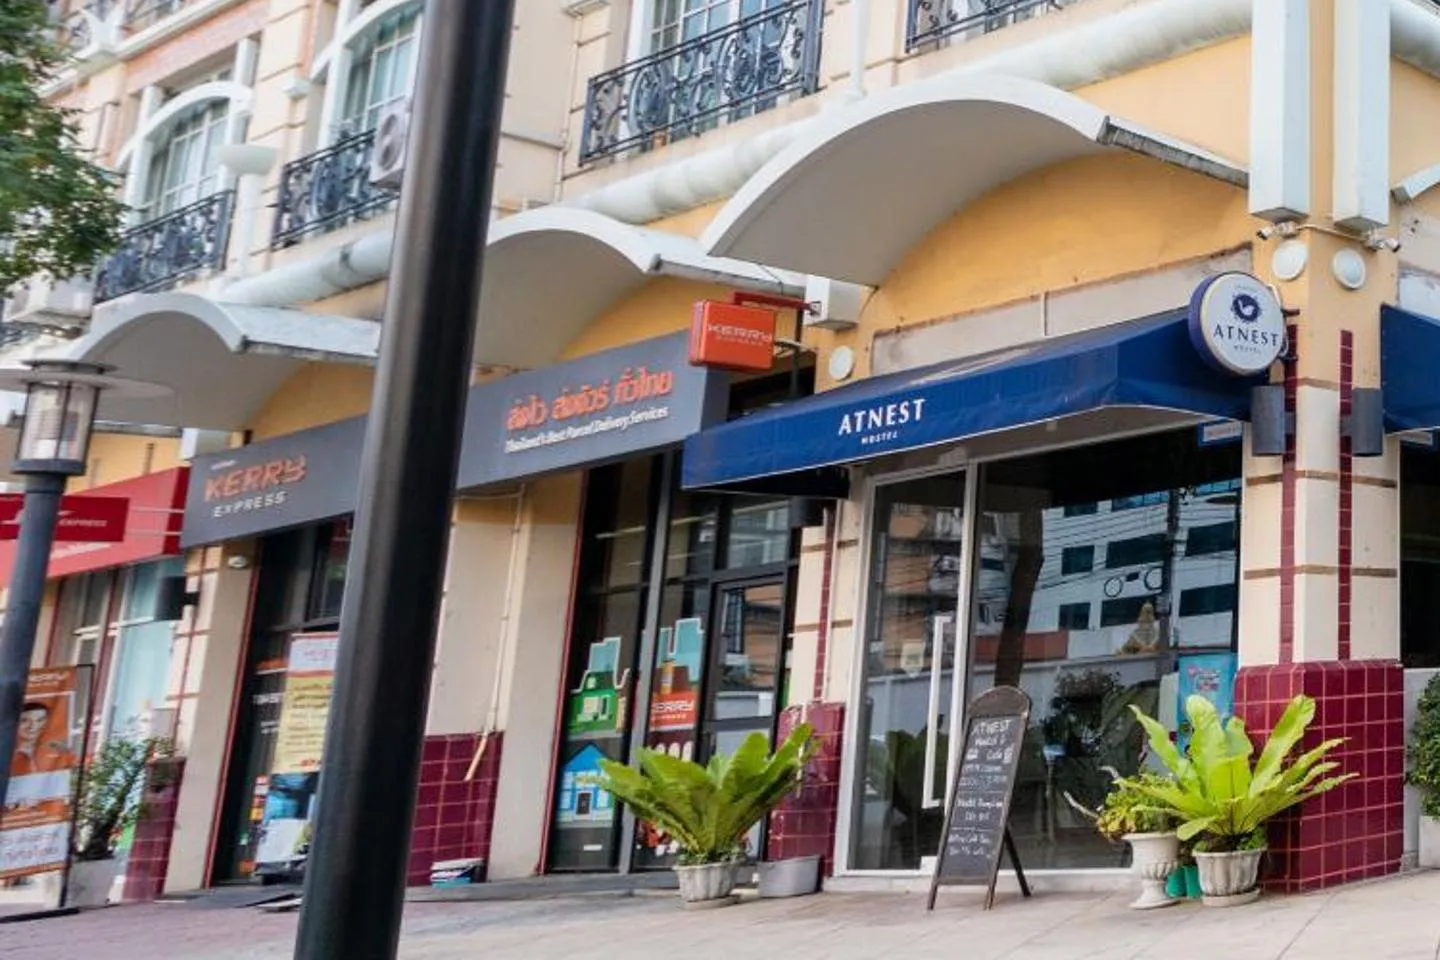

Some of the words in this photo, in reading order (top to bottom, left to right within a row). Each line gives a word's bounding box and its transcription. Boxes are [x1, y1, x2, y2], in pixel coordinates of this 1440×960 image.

[1212, 323, 1279, 347] ATNEST
[838, 398, 926, 436] ATNEST
[203, 452, 307, 502] KERRY
[213, 491, 288, 517] EXPRESS
